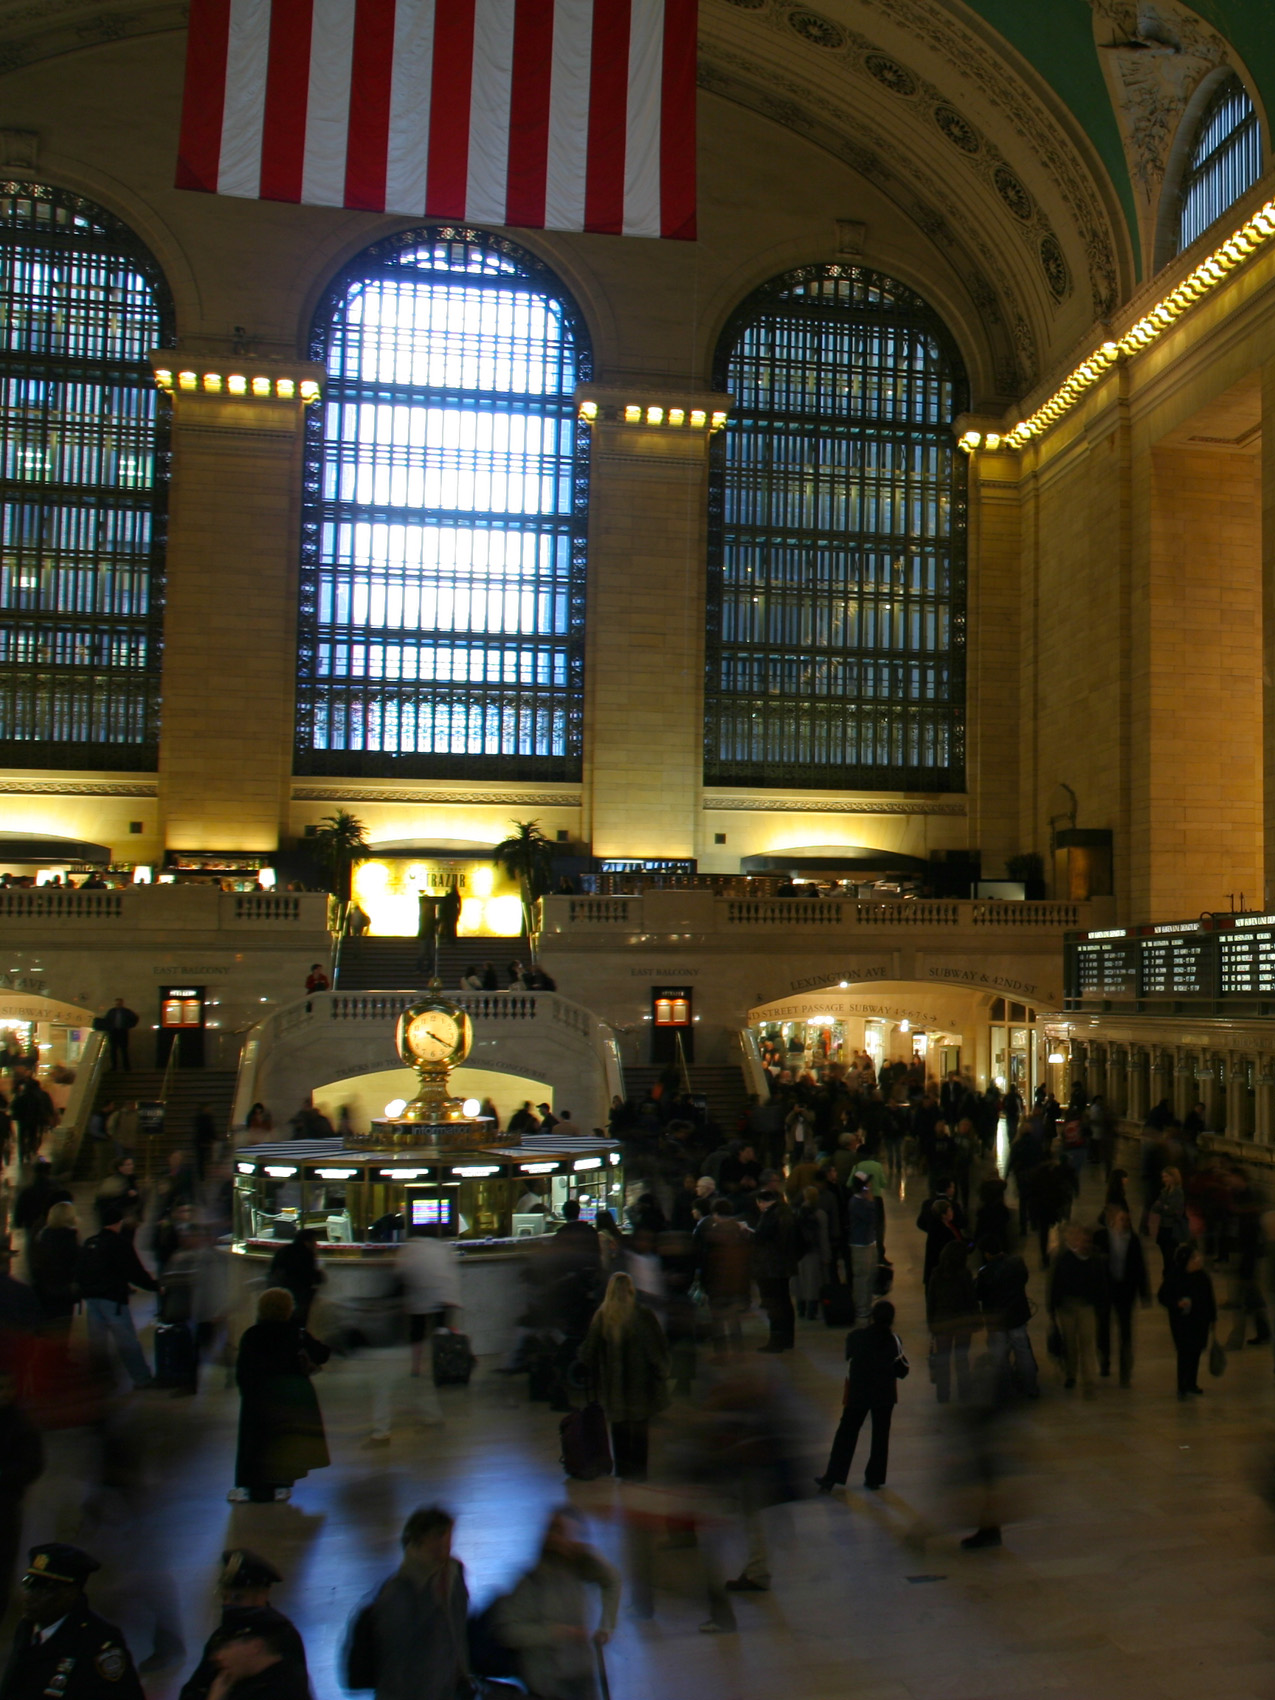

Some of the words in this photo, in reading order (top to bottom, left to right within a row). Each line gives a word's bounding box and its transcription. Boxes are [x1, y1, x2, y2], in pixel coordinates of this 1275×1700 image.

[630, 968, 654, 976] EAST
[790, 968, 861, 991] LEXINGTON
[865, 966, 888, 978] AVE
[928, 967, 978, 981] SUBWAY
[979, 974, 989, 983] &
[992, 976, 1022, 990] 42ND
[1024, 984, 1038, 994] ST
[762, 1006, 798, 1017] STREET
[802, 1004, 844, 1013] PASSAGE
[850, 1004, 892, 1014] SUBWAY
